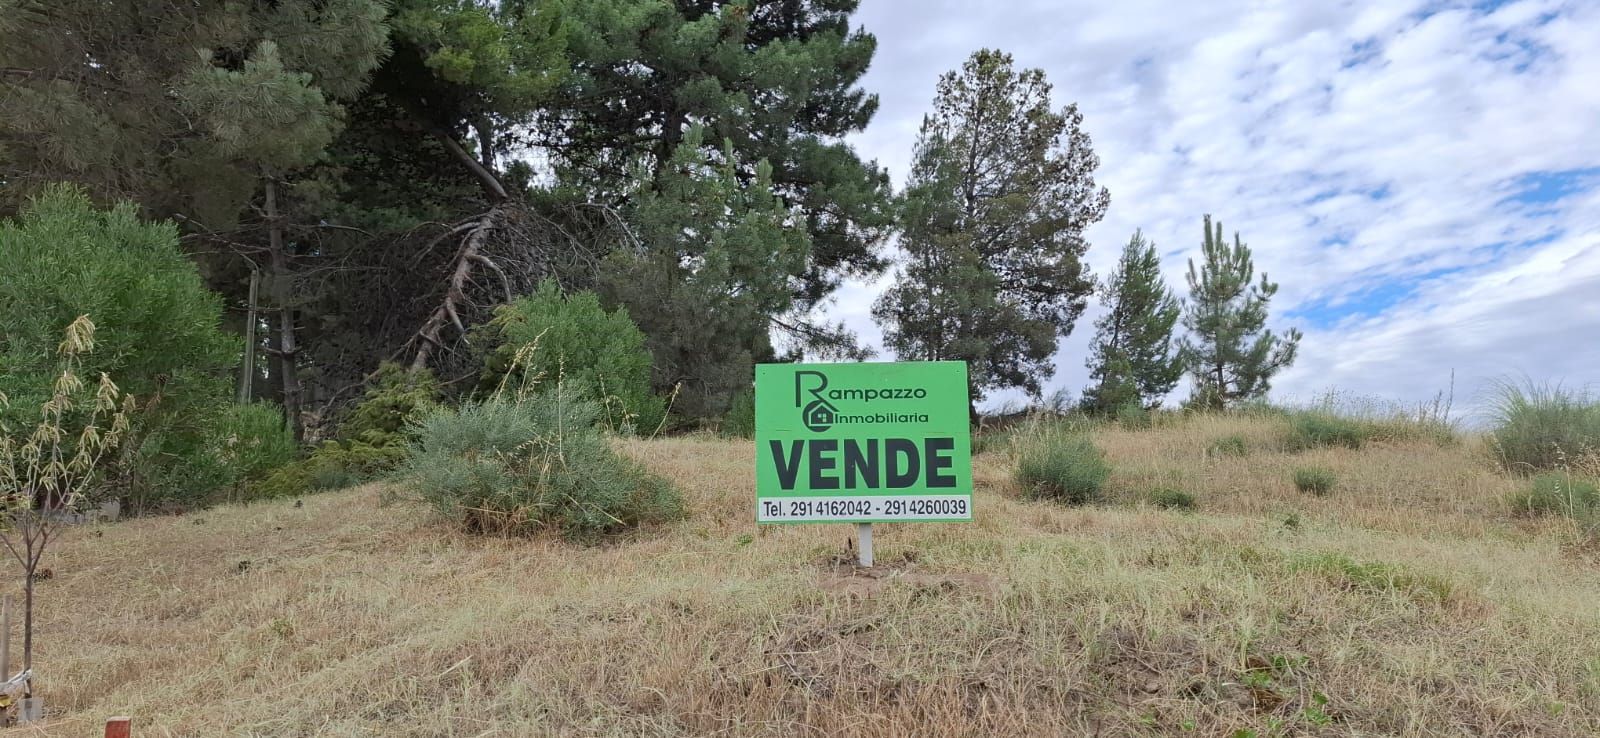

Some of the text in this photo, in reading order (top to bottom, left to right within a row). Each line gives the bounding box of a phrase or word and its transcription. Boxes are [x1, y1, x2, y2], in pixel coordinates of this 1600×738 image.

[795, 370, 927, 412] Rampazzo
[835, 412, 929, 424] Inmobiliaria
[769, 437, 957, 490] VENDE
[763, 501, 786, 517] Tel.
